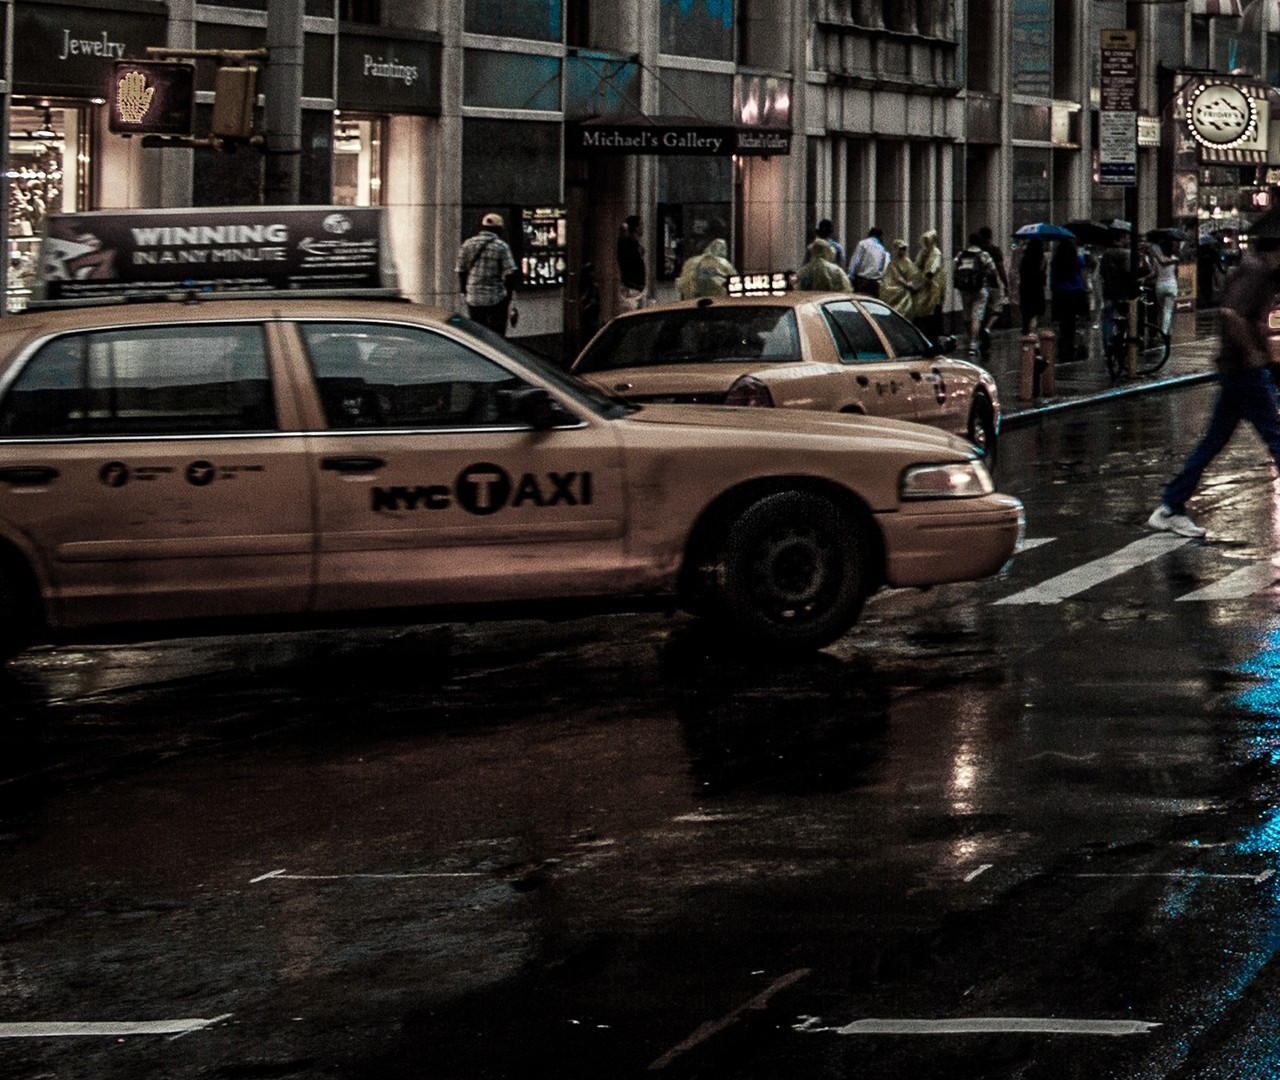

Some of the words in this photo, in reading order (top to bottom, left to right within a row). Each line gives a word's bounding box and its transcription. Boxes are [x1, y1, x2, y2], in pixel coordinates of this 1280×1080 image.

[60, 29, 126, 59] Jewelry
[363, 55, 418, 86] Paintings
[582, 131, 658, 148] Michael's
[663, 131, 724, 153] Gallery
[131, 224, 288, 246] WINNING
[370, 485, 452, 512] NYC
[458, 466, 593, 512] TAXI
